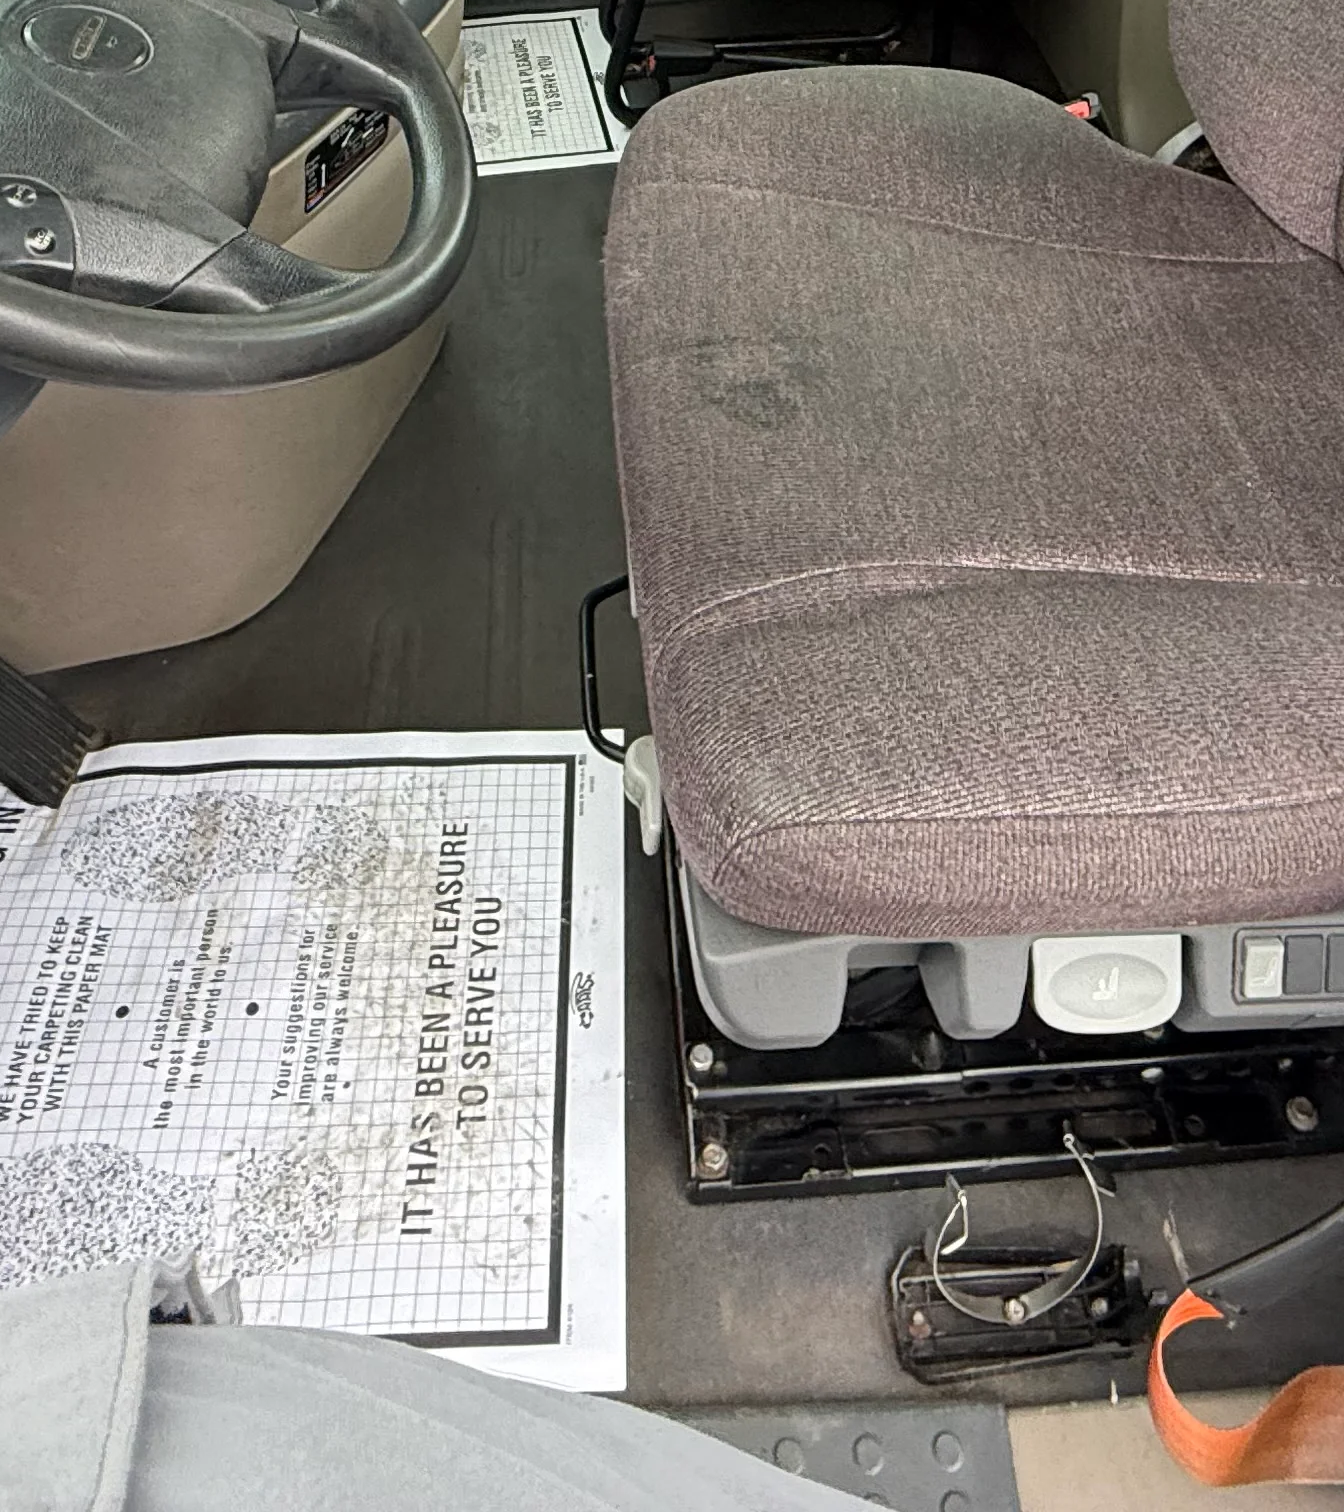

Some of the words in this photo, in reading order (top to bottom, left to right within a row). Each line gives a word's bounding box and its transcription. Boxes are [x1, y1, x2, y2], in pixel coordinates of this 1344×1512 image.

[512, 38, 533, 77] PLEASURE
[536, 56, 554, 72] YOU
[522, 86, 541, 109] BEEN
[541, 72, 561, 100] SERVE
[546, 100, 564, 113] TO
[526, 109, 545, 128] HAS
[428, 822, 469, 969] PLEASURE
[45, 916, 70, 955] KEEP
[196, 908, 219, 961] person
[470, 897, 502, 957] YOU
[37, 960, 56, 980] TO
[318, 923, 339, 980] service
[210, 969, 227, 984] to
[313, 984, 327, 1011] our
[425, 980, 454, 999] A
[16, 1070, 46, 1125] YOUR
[34, 971, 77, 1064] CARPETING
[65, 916, 94, 965] CLEAN
[19, 986, 49, 1035] TRIED
[42, 1063, 71, 1112] WITH
[58, 1020, 84, 1058] THIS
[72, 963, 102, 1014] PAPER
[91, 924, 112, 957] MAT
[150, 978, 179, 1051] customer
[169, 967, 205, 1044] important
[200, 988, 222, 1034] world
[271, 1059, 293, 1100] Your
[282, 954, 312, 1054] suggestions
[298, 929, 315, 949] for
[461, 966, 497, 1070] SERVE
[190, 1039, 211, 1067] the
[325, 1007, 348, 1066] always
[415, 1013, 451, 1096] BEEN
[4, 1040, 32, 1087] HAVE
[143, 1057, 160, 1069] A
[164, 1049, 185, 1092] most
[321, 1073, 337, 1103] are
[456, 1084, 488, 1130] TO
[152, 1100, 173, 1129] the
[405, 1113, 440, 1189] HAS
[400, 1201, 433, 1235] IT
